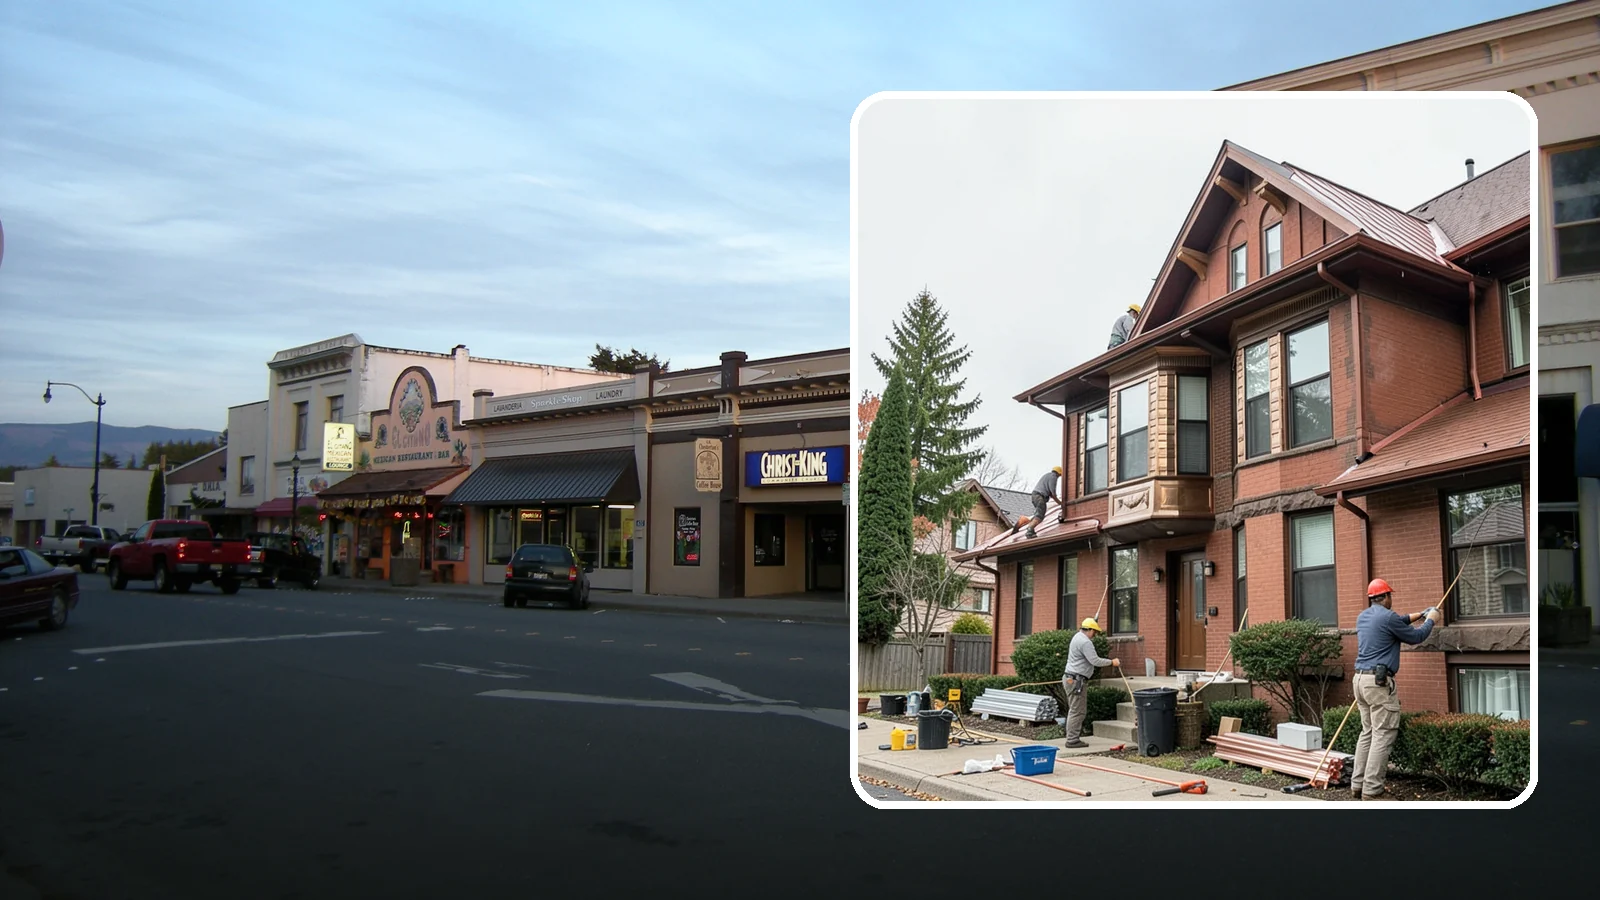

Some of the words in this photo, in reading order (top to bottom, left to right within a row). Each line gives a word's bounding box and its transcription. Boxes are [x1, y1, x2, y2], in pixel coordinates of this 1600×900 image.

[493, 402, 523, 412] LAVANDERIA
[530, 397, 561, 409] Sparkle
[562, 395, 582, 405] Shop
[595, 389, 624, 400] LAUNDRY
[374, 454, 396, 464] MEXICAN
[397, 451, 433, 462] RESTAURANT
[438, 450, 450, 459] BAR
[760, 452, 797, 478] CHRIST
[799, 450, 828, 476] KING
